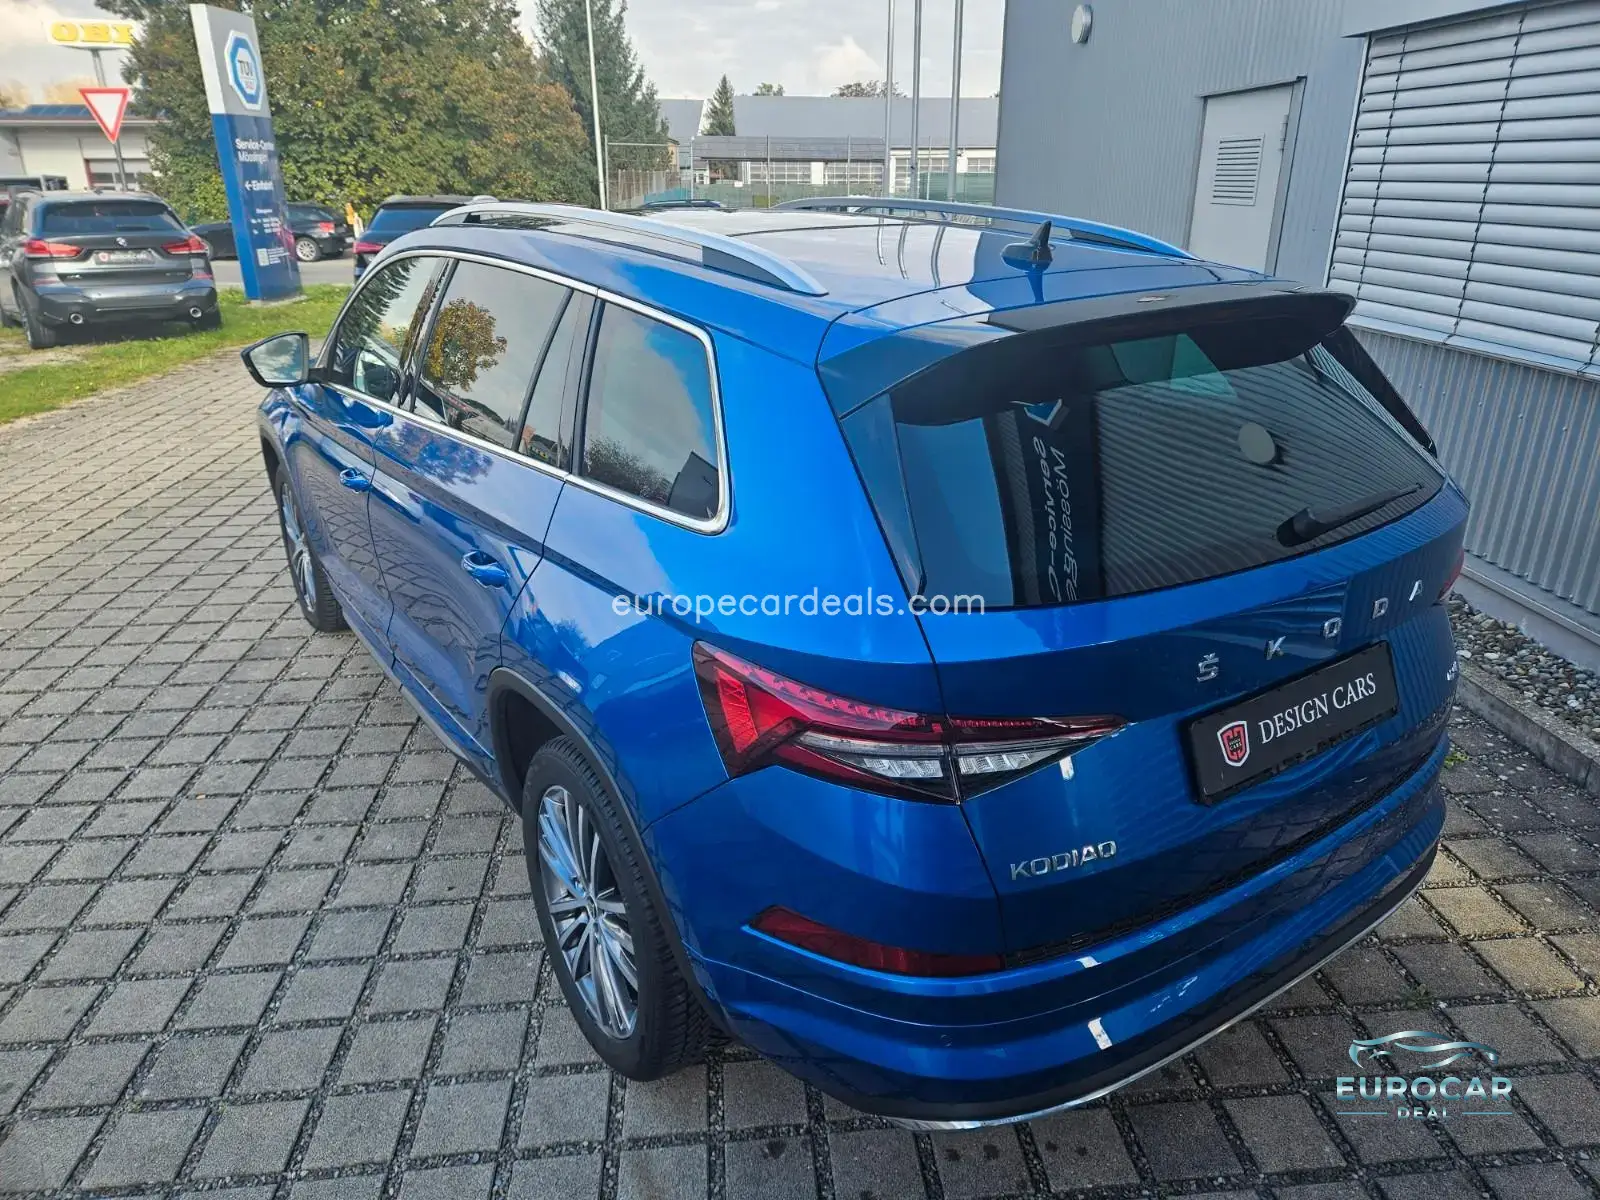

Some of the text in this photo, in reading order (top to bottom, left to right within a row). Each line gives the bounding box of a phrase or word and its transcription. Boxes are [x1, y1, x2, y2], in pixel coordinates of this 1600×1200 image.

[51, 22, 133, 43] OBI
[1197, 580, 1423, 682] ŠKODA
[1258, 673, 1377, 744] DESIGN CARS
[1010, 840, 1117, 880] KODIAQ
